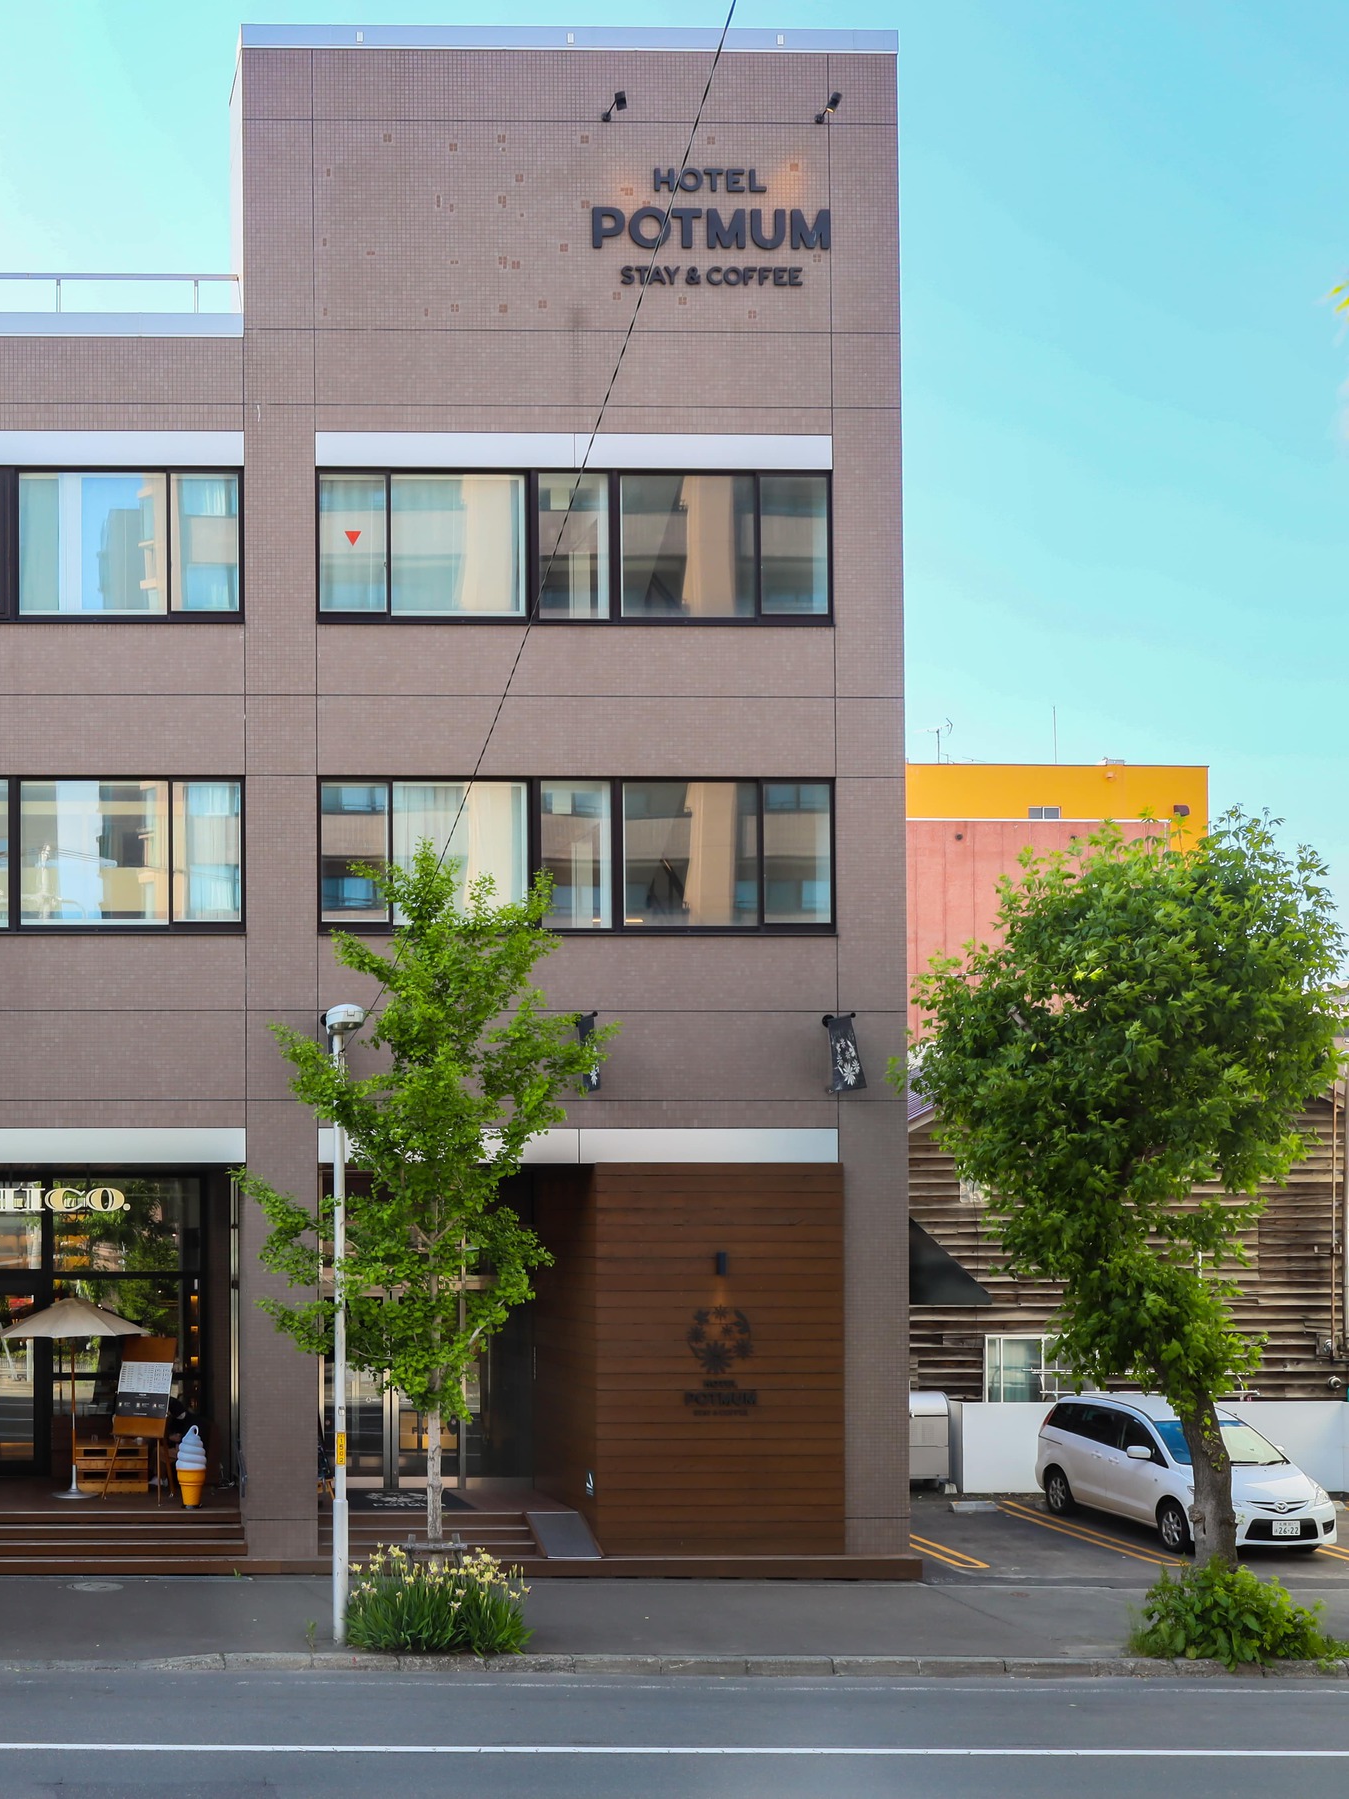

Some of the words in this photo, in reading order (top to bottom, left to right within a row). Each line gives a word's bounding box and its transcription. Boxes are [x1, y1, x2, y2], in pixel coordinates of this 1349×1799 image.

[653, 168, 767, 192] HOTEL
[592, 206, 831, 249] POTMUM
[620, 265, 680, 285] STAY
[685, 266, 701, 284] &
[706, 266, 803, 286] COFFEE
[684, 1391, 757, 1406] POTMUM
